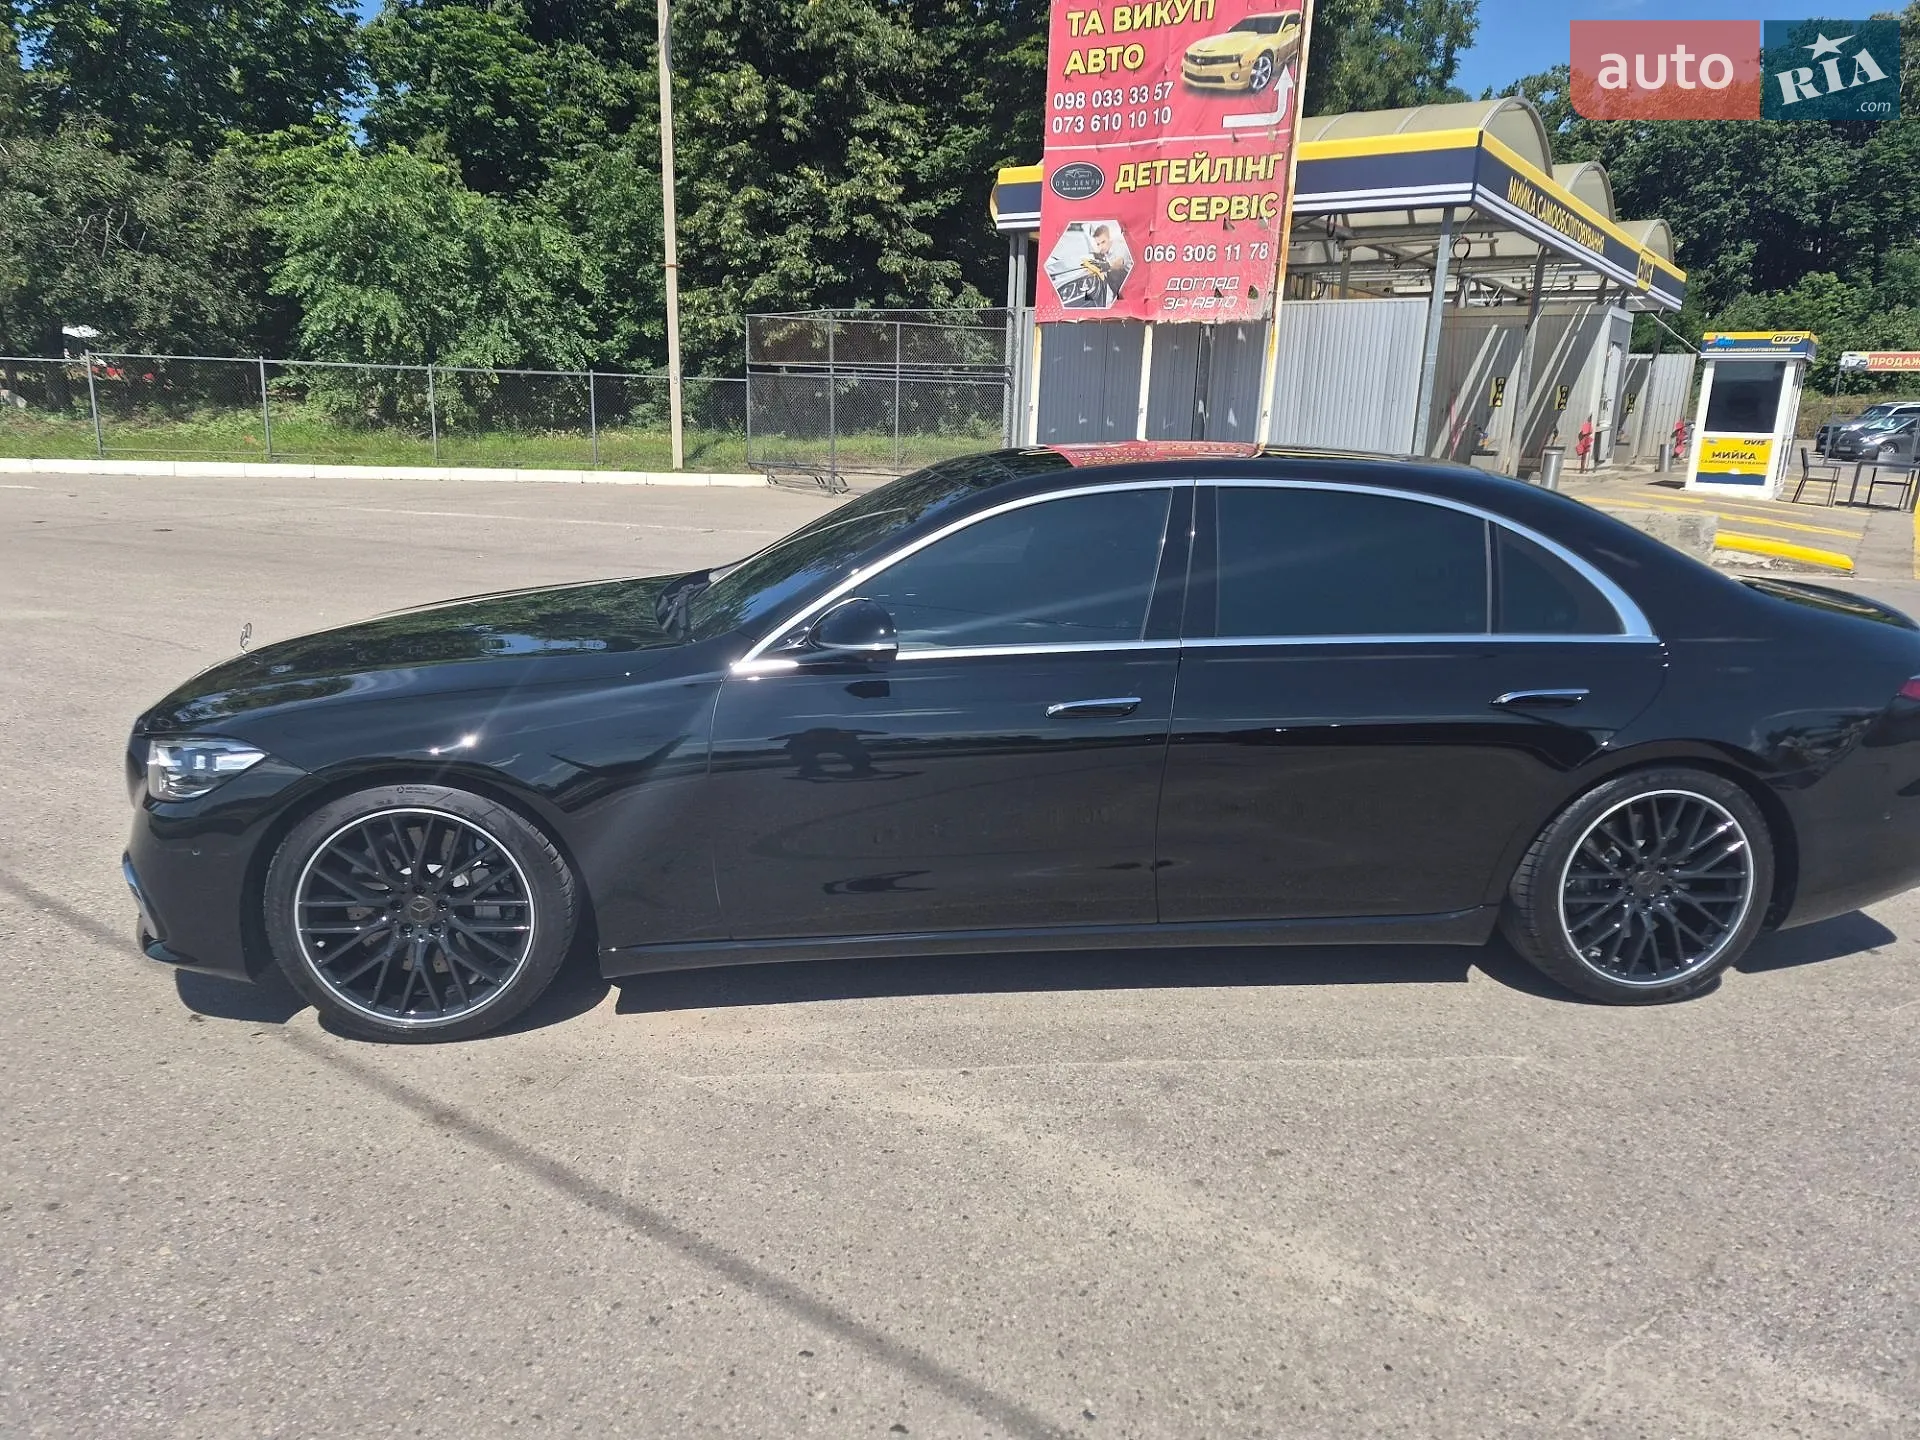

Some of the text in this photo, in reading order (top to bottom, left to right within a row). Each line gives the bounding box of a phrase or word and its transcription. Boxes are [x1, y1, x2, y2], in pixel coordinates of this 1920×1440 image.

[1066, 0, 1215, 37] ТА ВИКУП
[1063, 43, 1145, 76] АВТО
[1053, 81, 1174, 110] 098 033 33 57
[1052, 106, 1172, 133] 073 610 10 10
[1113, 150, 1284, 193] ДЕТЕЙЛІНГ
[1167, 192, 1279, 222] СЕРВІС
[1144, 242, 1269, 262] 066 306 11 78
[1165, 276, 1240, 291] ДОГЛЯД
[1192, 296, 1238, 310] АВТО
[1774, 334, 1802, 343] OVIS
[1711, 450, 1757, 460] МИЙКА
